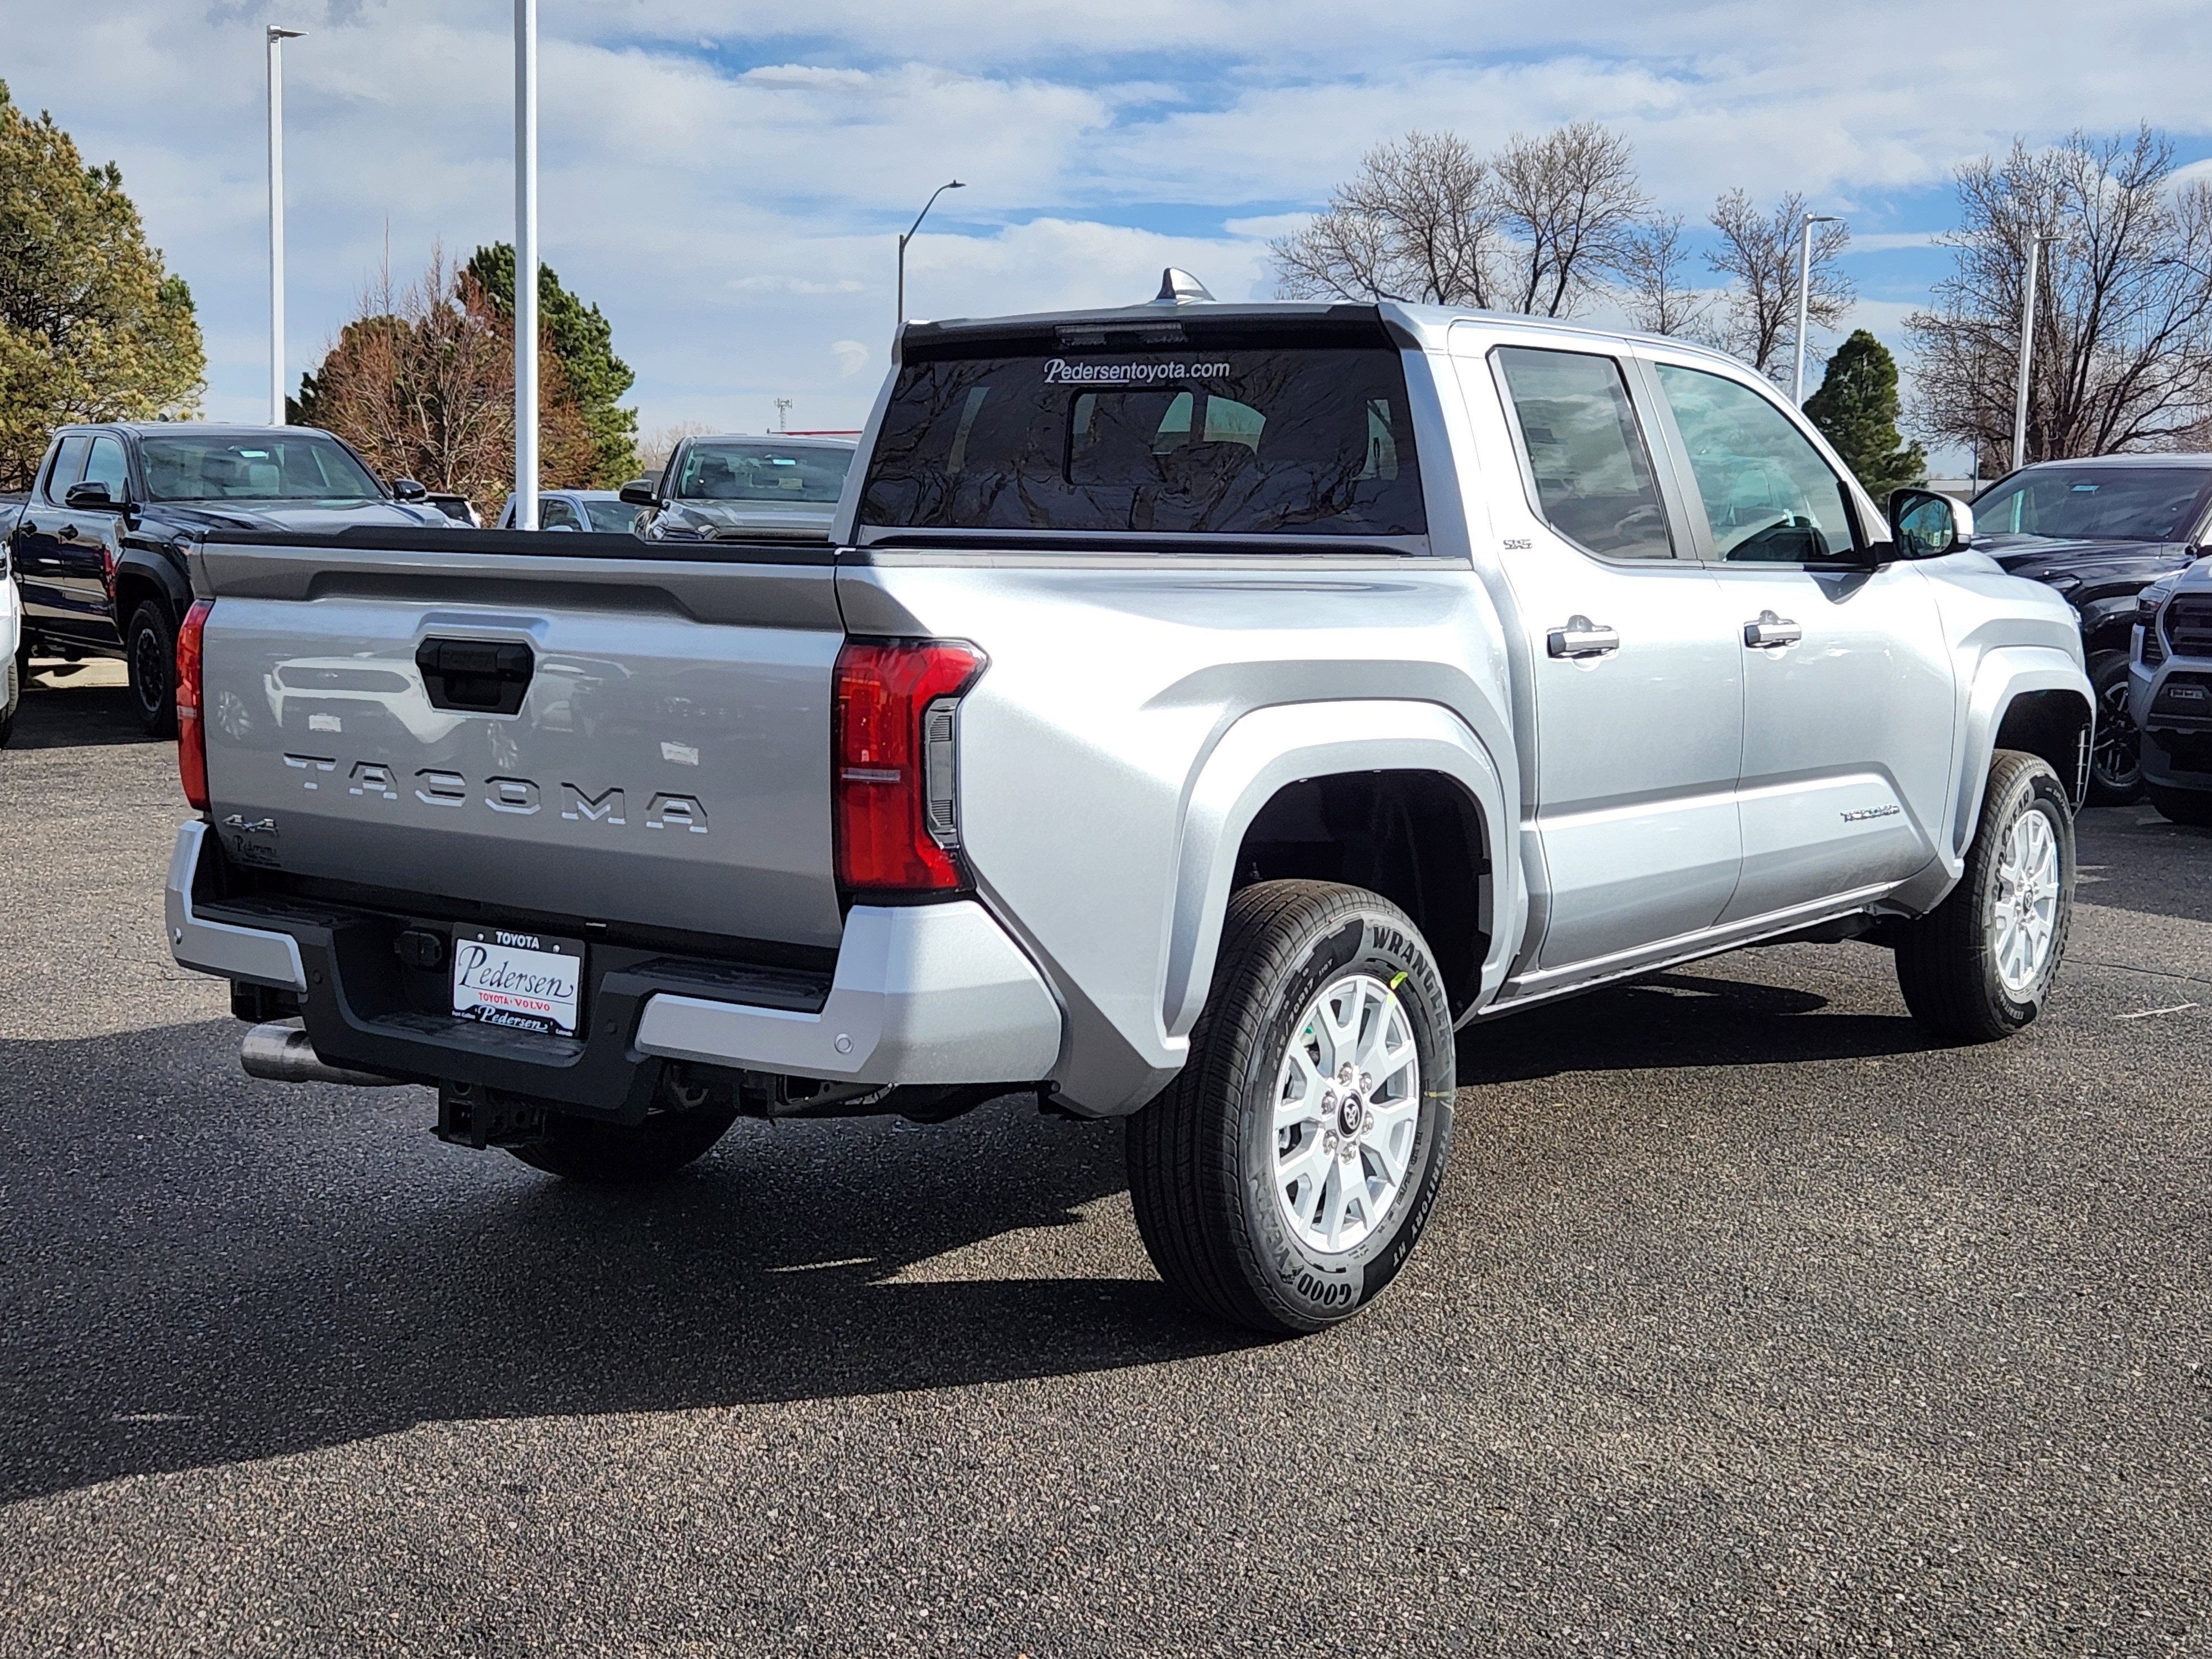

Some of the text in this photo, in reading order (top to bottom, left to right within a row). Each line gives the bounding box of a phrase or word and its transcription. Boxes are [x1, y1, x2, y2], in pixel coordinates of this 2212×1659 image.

[1044, 358, 1230, 383] Pedersentoyota.com
[283, 753, 708, 833] TACOMA
[495, 931, 540, 949] TOYOTA
[458, 945, 574, 998] Pedersen
[478, 992, 550, 1011] TOYOTA VOLVO
[478, 1005, 548, 1030] Pedersen
[1392, 1241, 1407, 1267] HT
